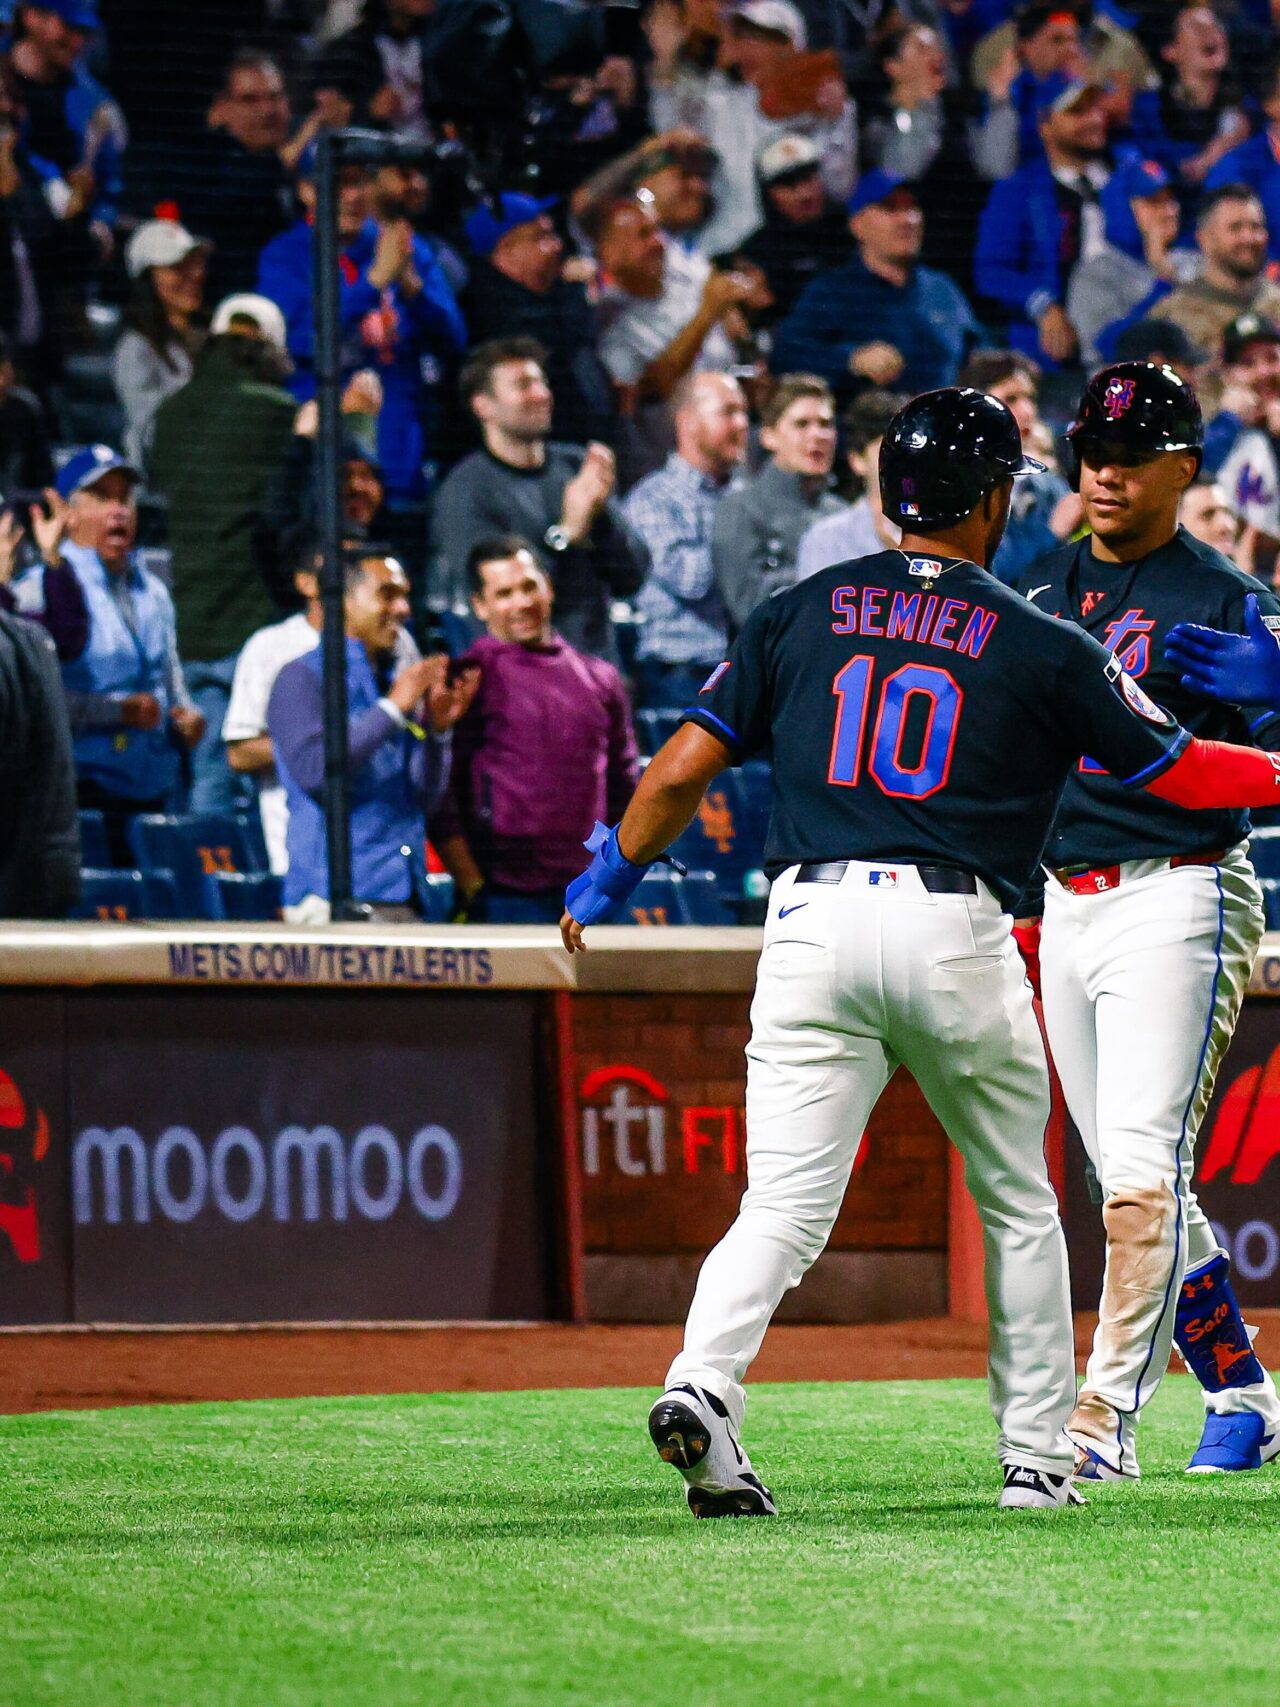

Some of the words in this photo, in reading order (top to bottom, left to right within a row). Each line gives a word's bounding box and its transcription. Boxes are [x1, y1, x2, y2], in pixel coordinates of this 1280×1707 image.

[831, 585, 998, 659] SEMIEN
[827, 654, 965, 801] 10
[169, 942, 494, 984] METS.COM/TEXTALERTS
[73, 1124, 463, 1224] moomoo
[682, 1104, 746, 1175] FI
